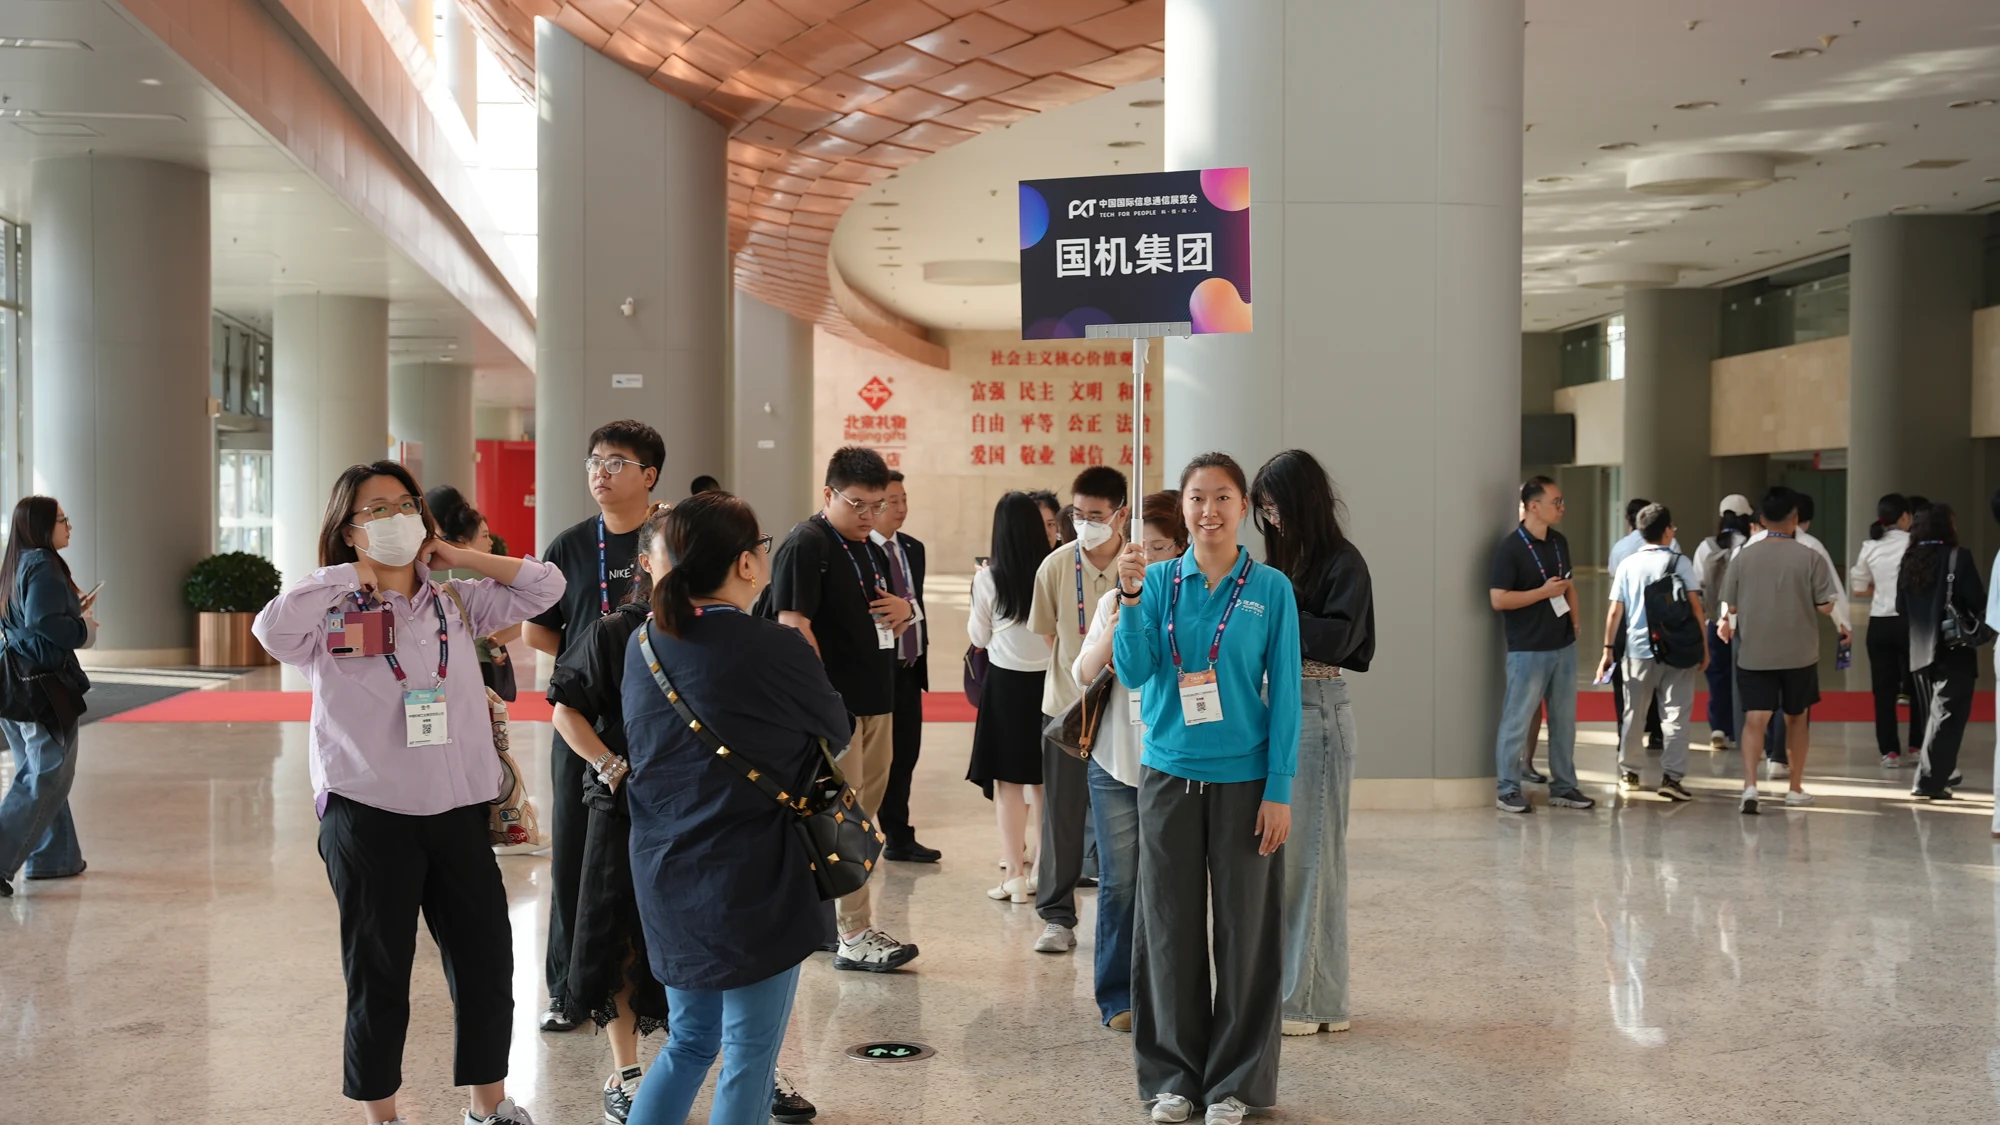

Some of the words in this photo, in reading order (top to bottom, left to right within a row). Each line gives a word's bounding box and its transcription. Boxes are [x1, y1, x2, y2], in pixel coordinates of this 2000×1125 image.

[1099, 194, 1198, 208] 中国国际信息通信展览会
[1056, 232, 1213, 278] 国机集团
[991, 350, 1134, 367] 社会主义核心价值观
[970, 380, 1006, 402] 富强
[1019, 381, 1054, 401] 民主
[1068, 381, 1103, 402] 文明
[972, 413, 1005, 433] 自由
[1020, 412, 1054, 433] 平等
[1068, 413, 1102, 433] 公正
[970, 445, 1005, 465] 爱国
[1020, 445, 1055, 465] 敬业
[1069, 445, 1103, 465] 诚信
[609, 568, 632, 580] NIKE
[509, 832, 526, 841] SOP
